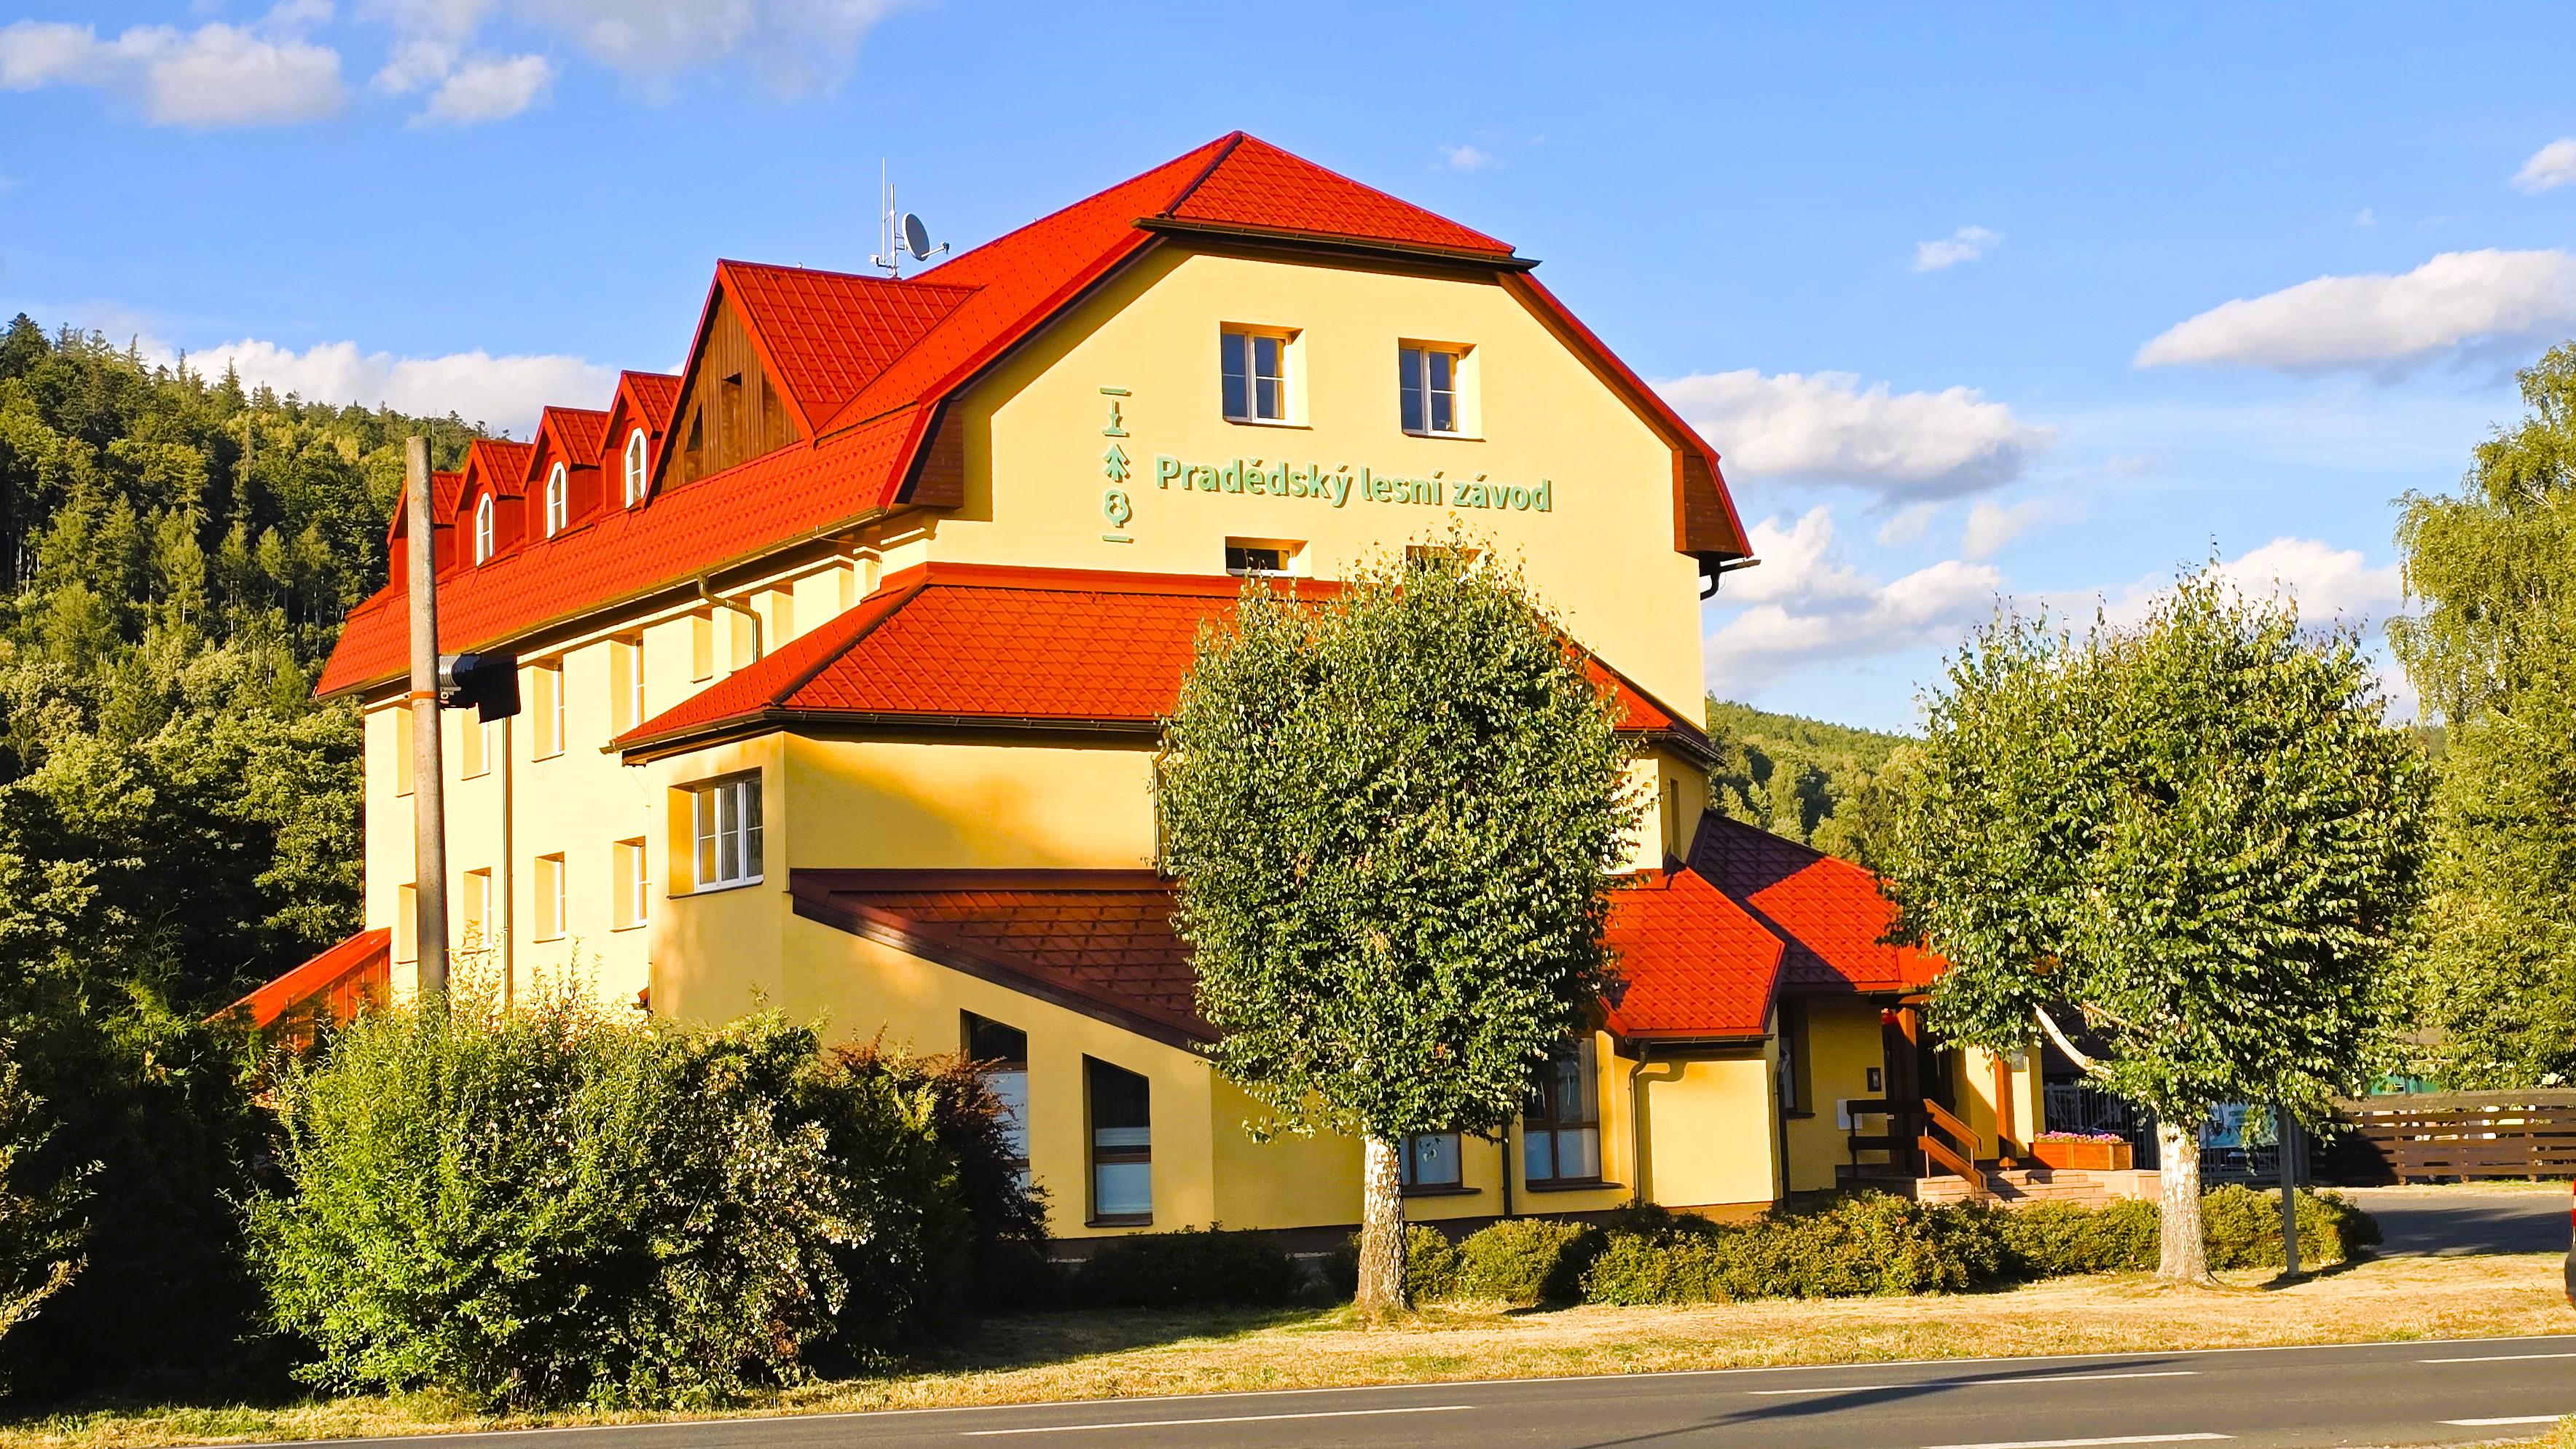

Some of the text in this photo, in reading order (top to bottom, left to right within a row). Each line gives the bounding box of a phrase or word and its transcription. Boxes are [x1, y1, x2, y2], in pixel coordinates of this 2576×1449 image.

[1156, 455, 1551, 511] Pradědský lesní závod
